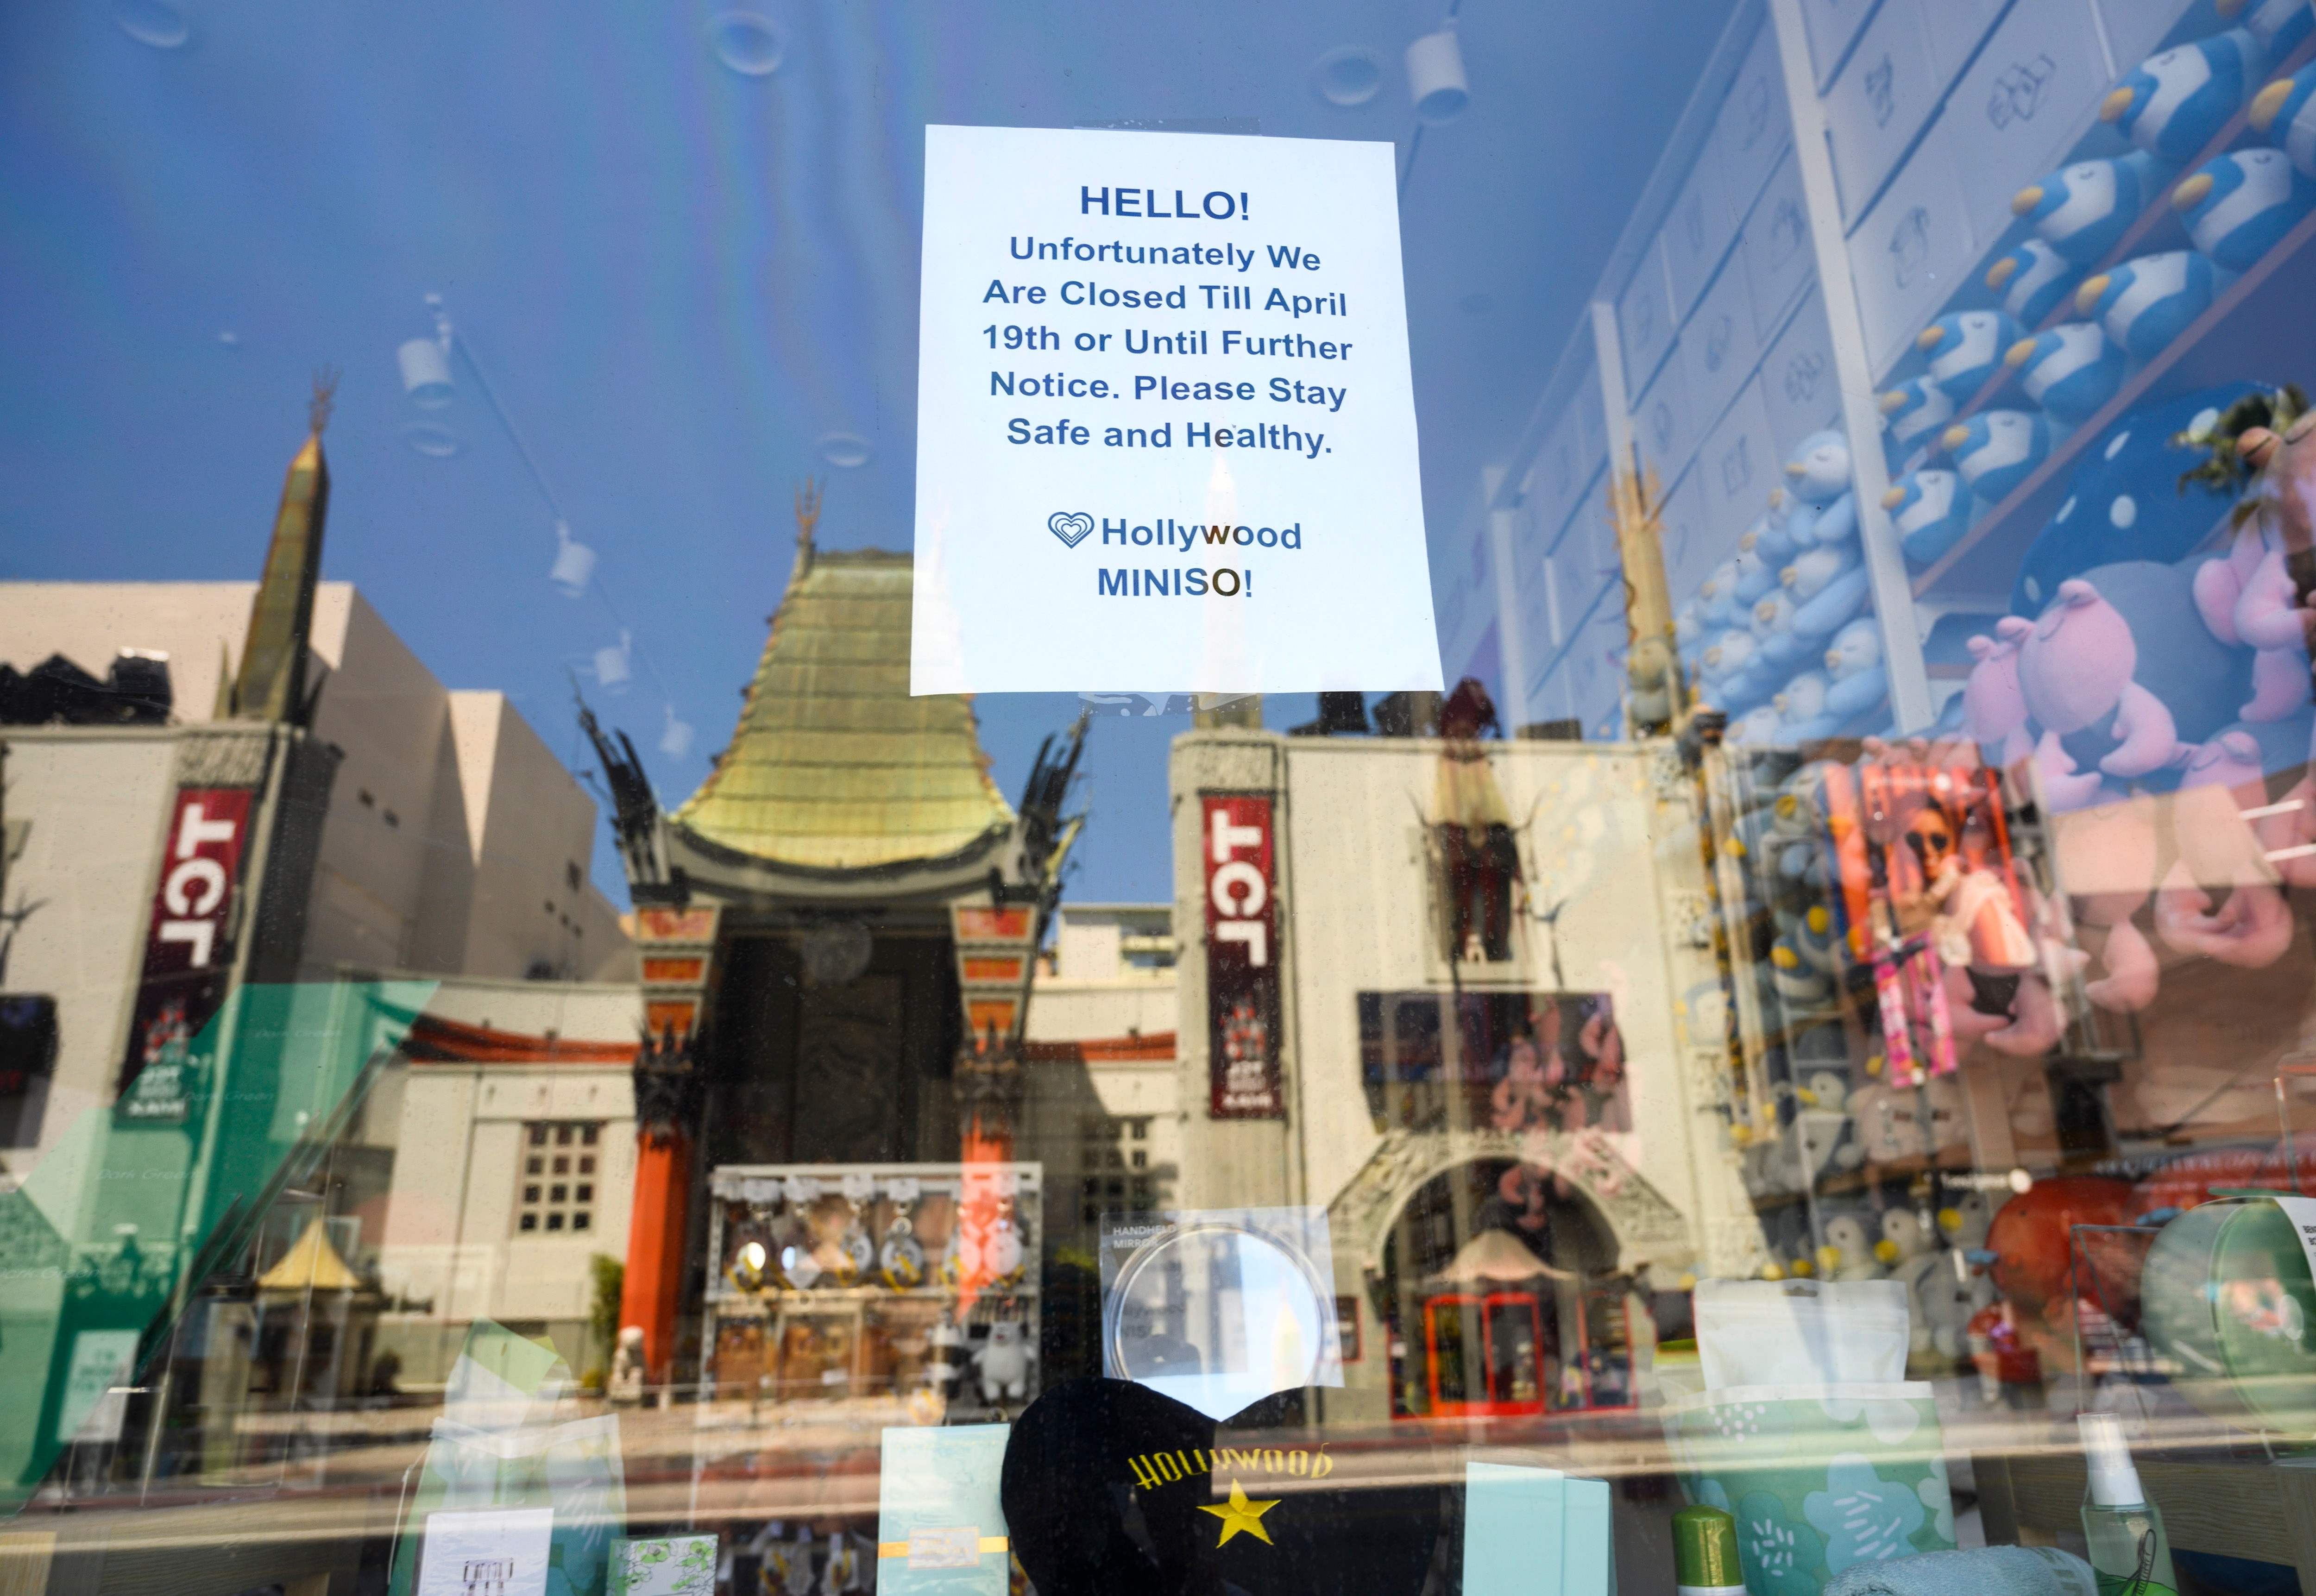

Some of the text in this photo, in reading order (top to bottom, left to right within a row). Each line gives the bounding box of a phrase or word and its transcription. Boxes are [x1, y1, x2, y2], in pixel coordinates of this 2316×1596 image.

[1082, 186, 1248, 220] HELLO!
[1011, 237, 1320, 272] Unfortunately We
[982, 280, 1346, 319] Are Closed Till April
[983, 325, 1353, 360] 19th or Until Further
[991, 371, 1347, 412] Notice. Please Stay
[1007, 418, 1331, 459] Safe and Healthy.
[1103, 518, 1301, 552] Hollywood
[1099, 568, 1251, 597] MINISO!
[1113, 1225, 1177, 1236] HANDHELD
[1114, 1238, 1158, 1248] MIRROR
[1128, 1442, 1333, 1489] HOLLYWOOD
